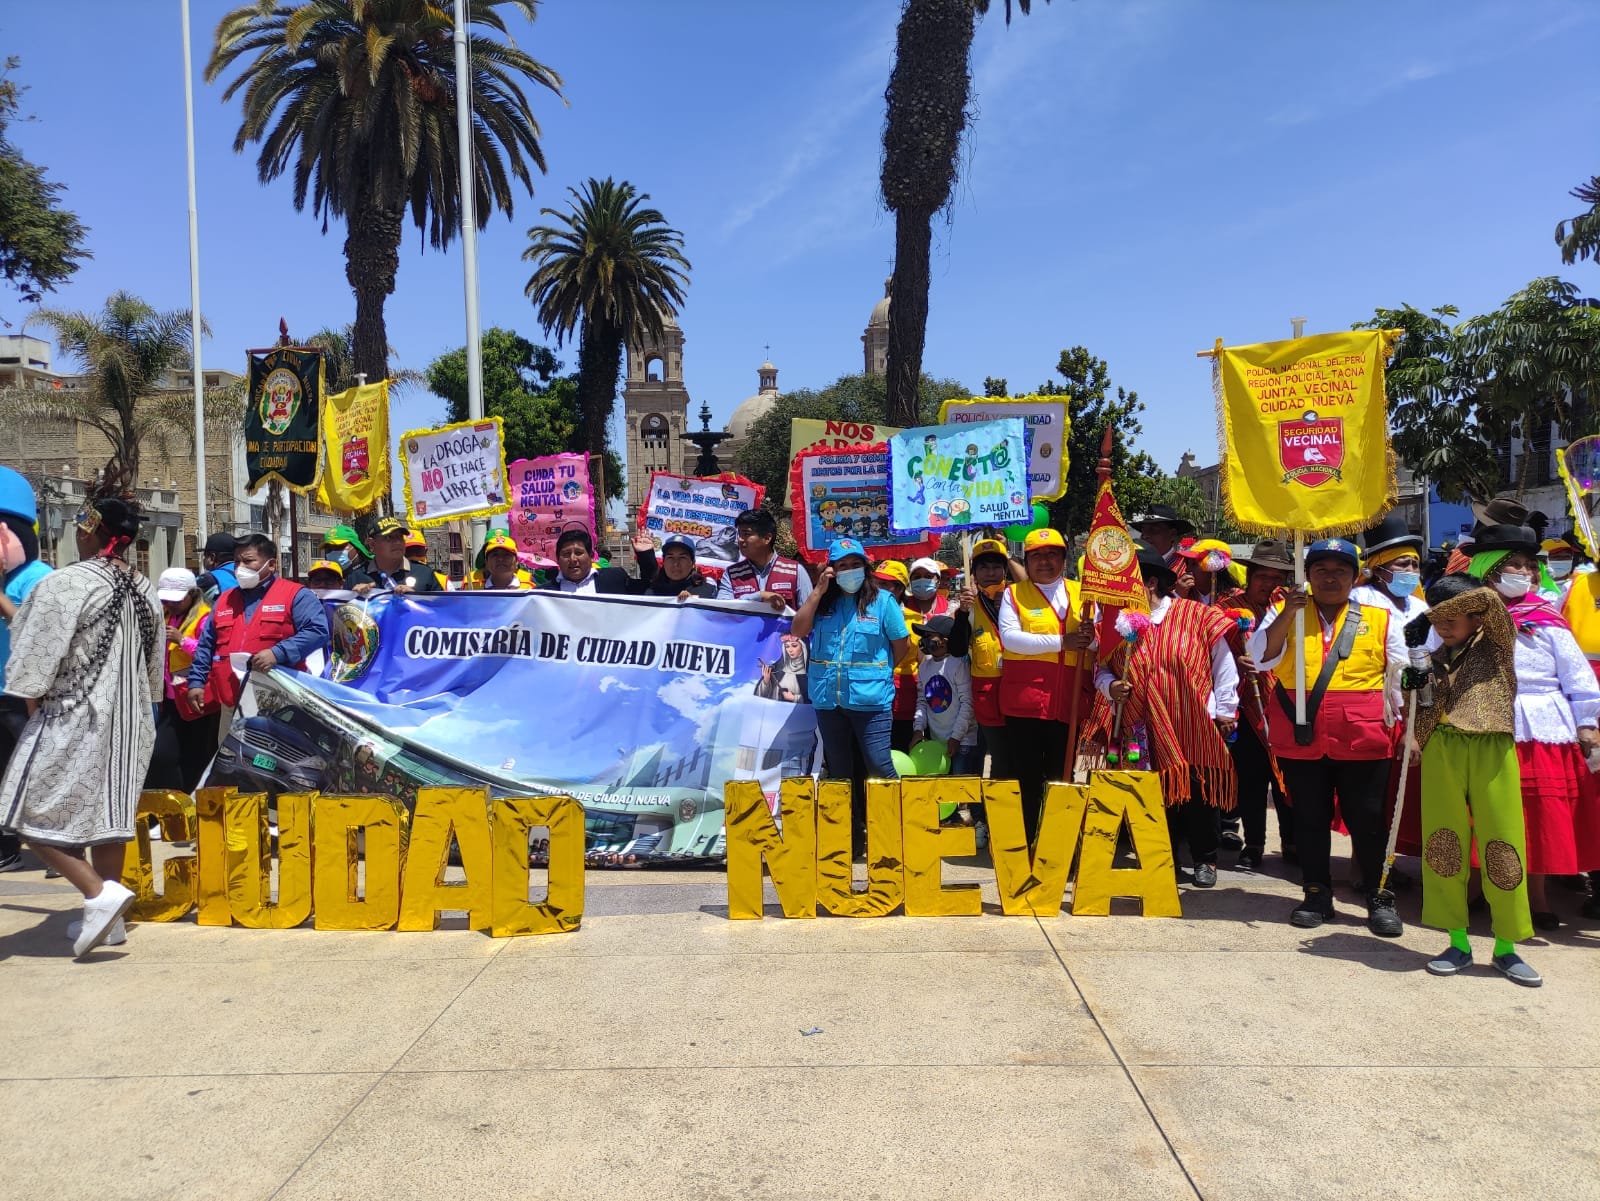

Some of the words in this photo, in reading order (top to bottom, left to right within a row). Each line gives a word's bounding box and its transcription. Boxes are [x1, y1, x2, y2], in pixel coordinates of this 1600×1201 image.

[1246, 367, 1278, 377] POLICIA
[1280, 362, 1323, 372] NACIONAL
[1326, 358, 1340, 367] DEL
[1344, 352, 1366, 365] PERÚ
[1248, 376, 1281, 388] REGION
[1285, 372, 1327, 385] POLICIAL
[1331, 367, 1365, 379] TACNA
[1257, 386, 1297, 400] JUNTA
[1303, 380, 1358, 395] VECINAL
[1260, 398, 1305, 413] CIUDAD
[1312, 393, 1355, 407] NUEVA
[825, 420, 875, 441] NOS
[1283, 426, 1338, 437] SEGURIDAD
[1284, 434, 1340, 447] VECINAL
[423, 455, 439, 470] LA
[436, 434, 483, 461] DROGA
[860, 453, 888, 464] COMU
[421, 468, 444, 492] NO
[444, 463, 459, 479] TE
[460, 457, 487, 475] HACE
[524, 467, 555, 482] CUIDA
[559, 464, 576, 478] TU
[844, 465, 861, 475] POR
[862, 464, 875, 475] LA
[1286, 467, 1309, 479] POLICIA
[1310, 466, 1340, 477] NACIONAL
[440, 477, 482, 504] LIBRE
[521, 480, 556, 495] SALUD
[961, 478, 1005, 499] VIDA
[520, 494, 563, 507] MENTAL
[657, 488, 670, 499] LA
[672, 490, 692, 503] VIDA
[692, 493, 704, 504] ES
[704, 496, 730, 510] SOLO
[730, 501, 748, 510] UNA
[979, 501, 1009, 513] SALUD
[655, 505, 670, 515] NO
[671, 507, 683, 518] LA
[993, 510, 1027, 521] MENTAL
[646, 516, 663, 530] EN
[665, 519, 713, 538] DROGAS
[408, 624, 531, 657] COMISARÍA
[539, 631, 570, 660] DE
[576, 636, 656, 666] CIUDAD
[661, 642, 730, 675] NUEVA
[577, 791, 593, 801] DE
[593, 793, 634, 805] CIUDAD
[635, 794, 671, 806] NUEVA
[122, 785, 586, 937] CIUDAD
[725, 770, 1183, 920] NUEVA
